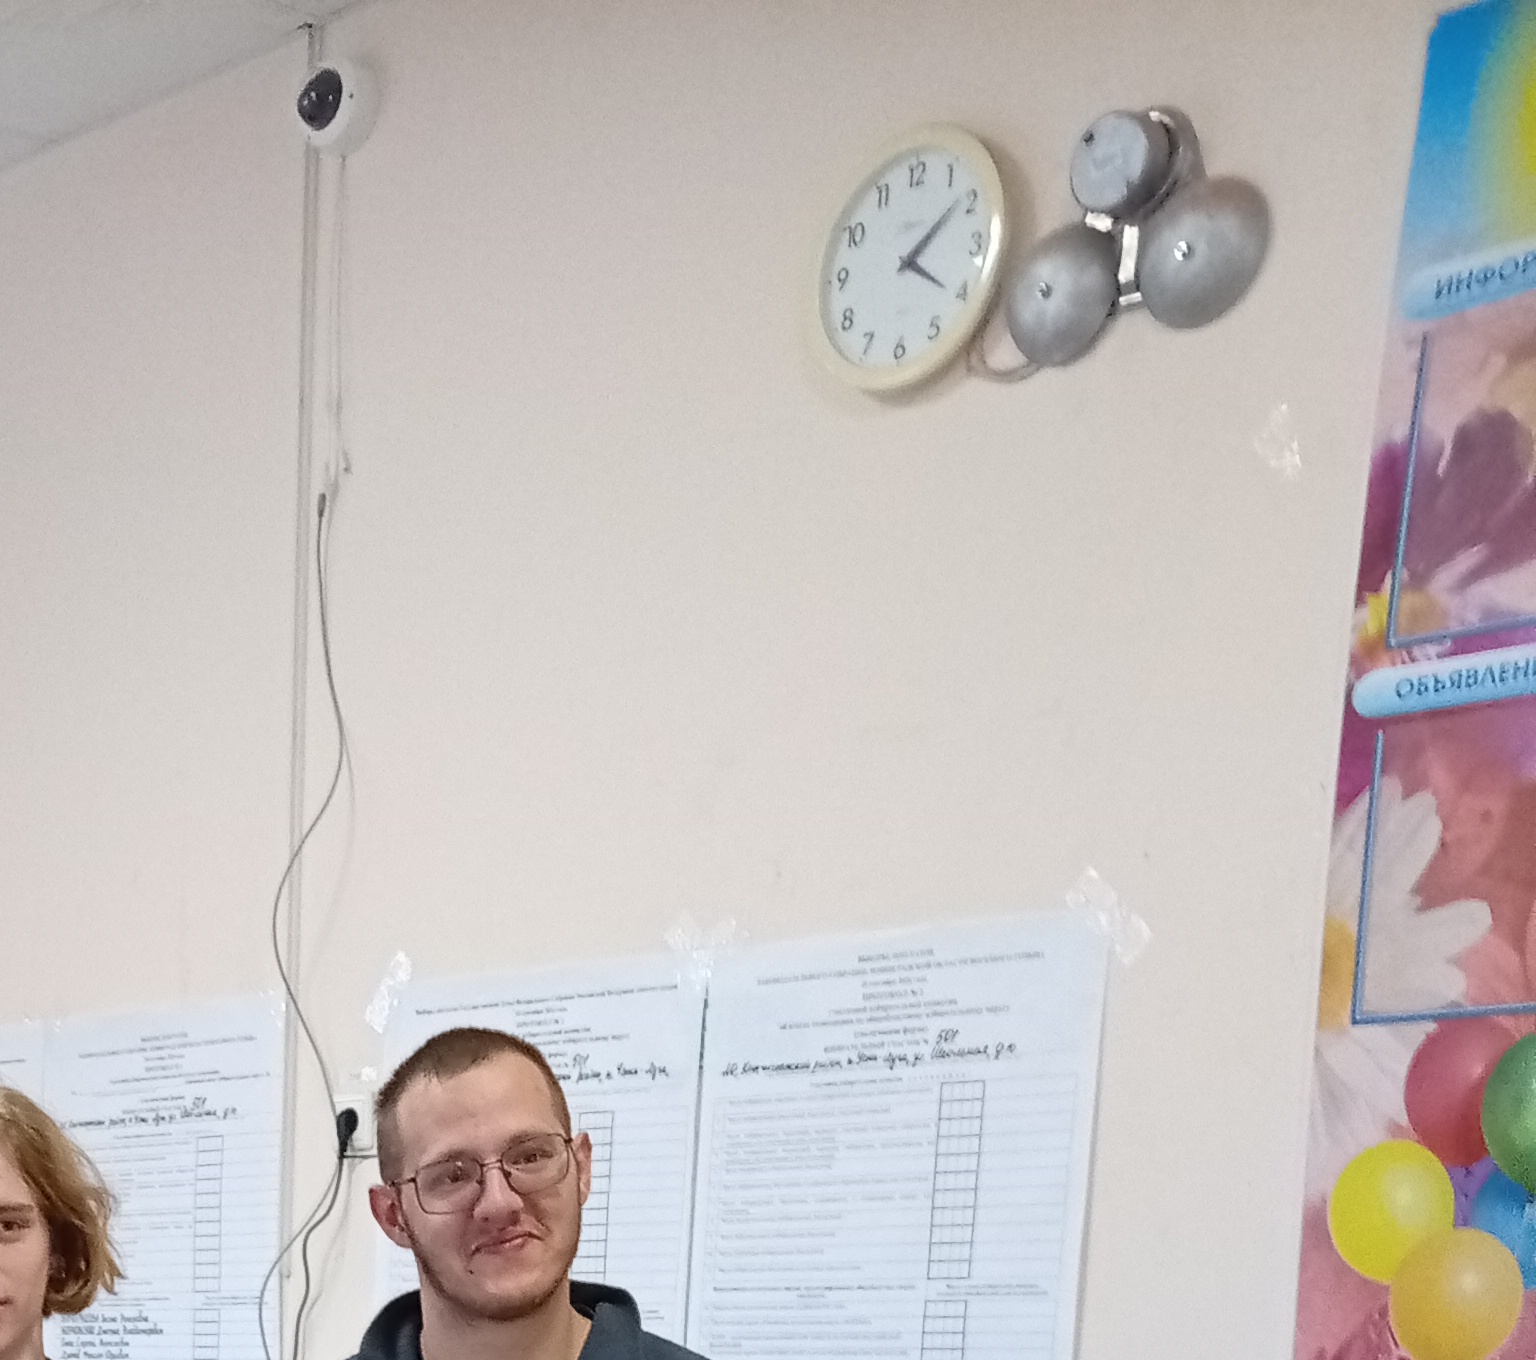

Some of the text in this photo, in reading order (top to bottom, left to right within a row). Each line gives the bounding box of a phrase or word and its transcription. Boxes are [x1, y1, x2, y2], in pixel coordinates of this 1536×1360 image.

[908, 159, 926, 189] 12
[946, 162, 954, 188] 1
[875, 182, 890, 211] 11
[965, 189, 978, 215] 2
[844, 222, 865, 248] 10
[968, 231, 982, 257] 3
[837, 266, 850, 292] 9
[955, 281, 967, 302] 4
[841, 307, 855, 332] 8
[927, 314, 941, 340] 5
[862, 331, 874, 358] 7
[893, 335, 906, 361] 6
[1395, 656, 1536, 699] ОБЪЯВЛЕН
